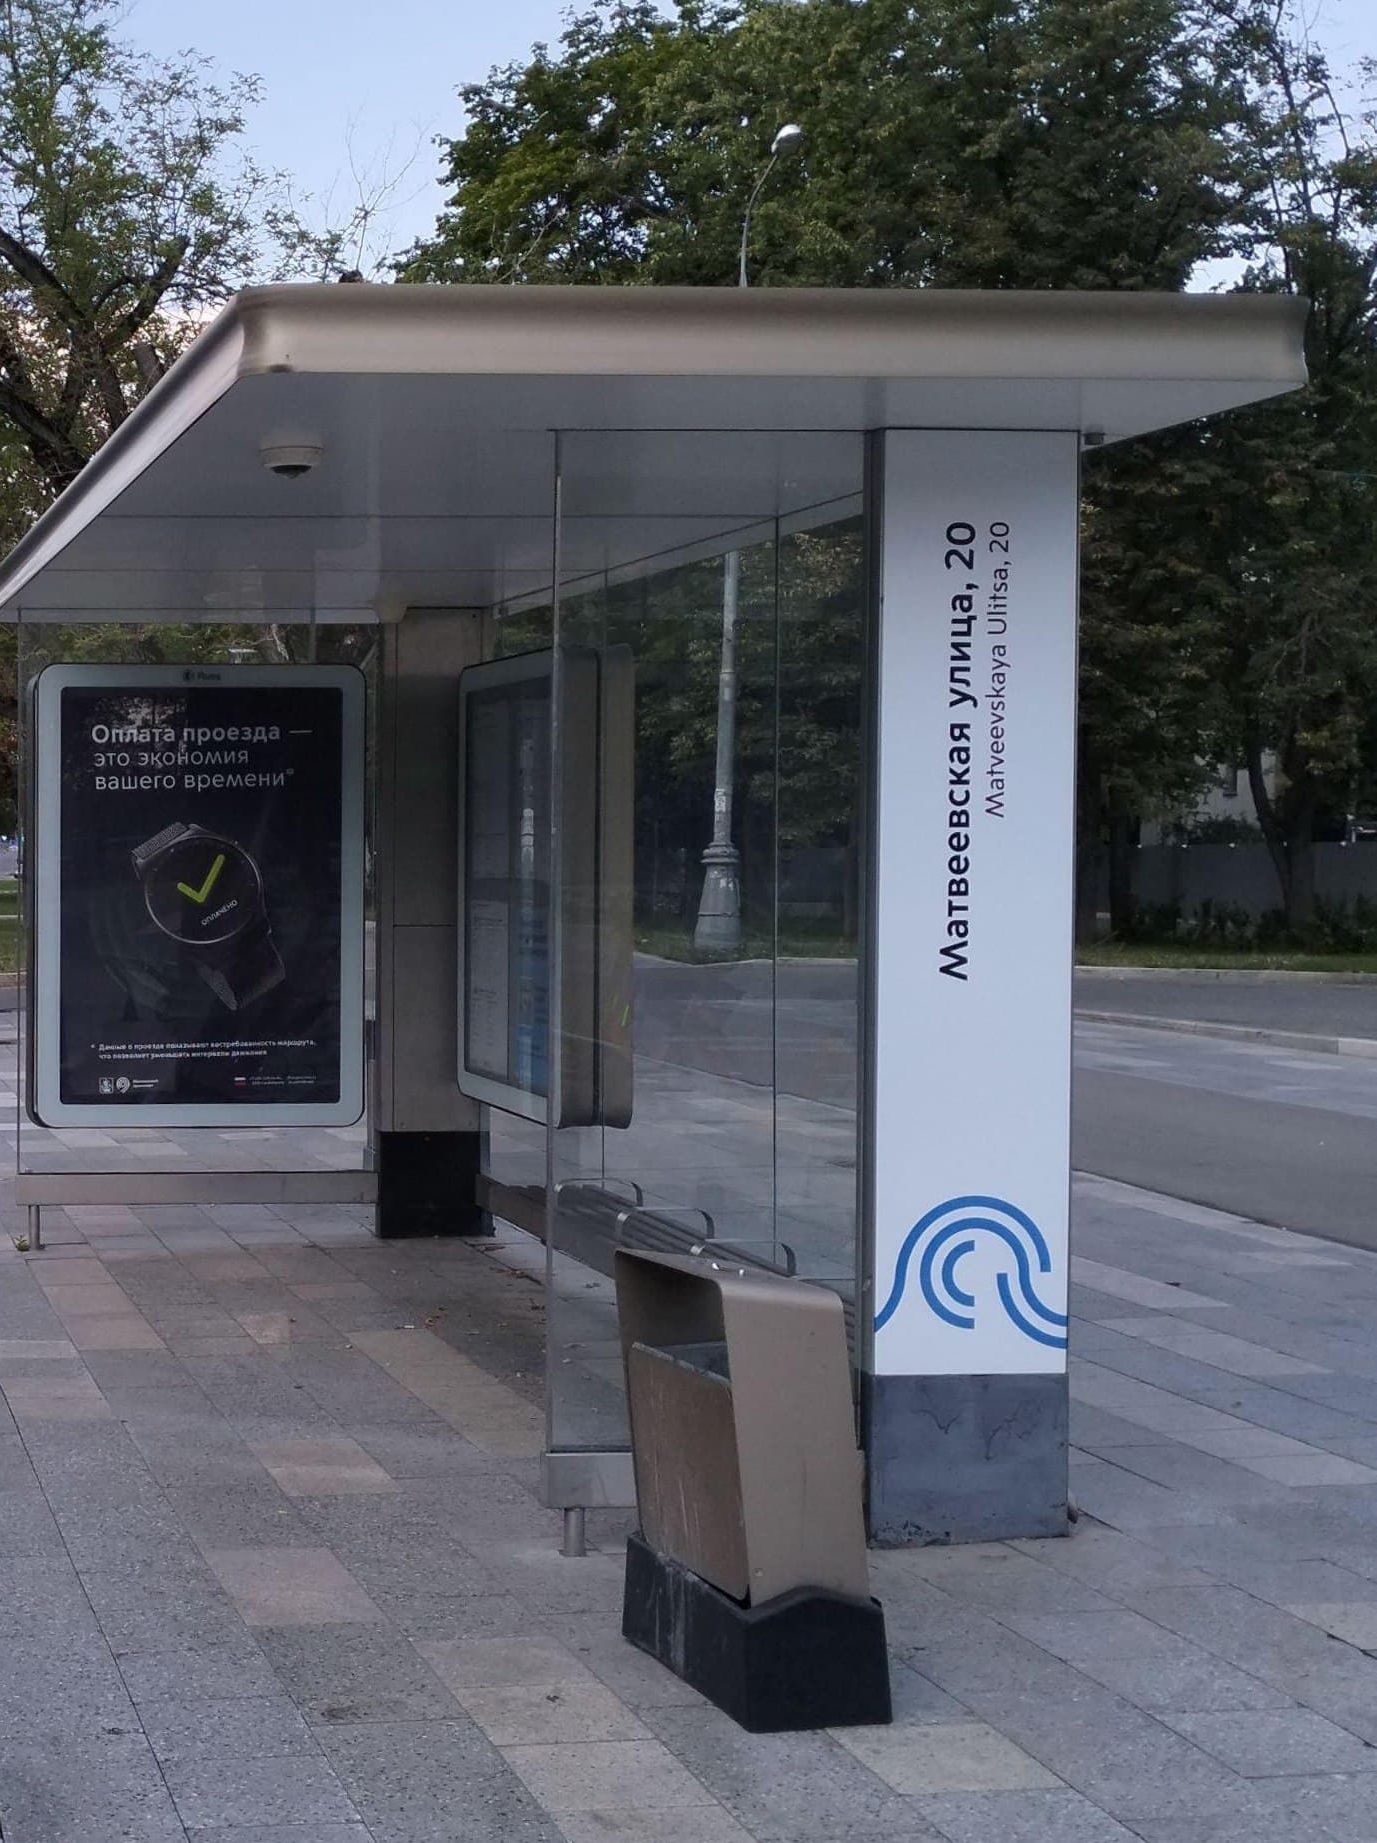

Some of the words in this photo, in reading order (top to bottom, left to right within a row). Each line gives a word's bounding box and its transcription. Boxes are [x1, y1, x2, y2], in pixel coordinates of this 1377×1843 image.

[944, 521, 976, 571] 20
[989, 521, 1010, 553] 20
[987, 559, 1010, 635] Ulitsa,
[947, 582, 977, 708] улица,
[91, 724, 176, 744] Оплата
[183, 724, 281, 746] проезда
[984, 643, 1011, 818] Matveevskaya
[94, 750, 130, 767] это
[138, 749, 249, 767] экономия
[95, 774, 176, 791] вашего
[939, 722, 971, 981] Матвеевская
[201, 899, 238, 926] ОПЛАЧЕНО
